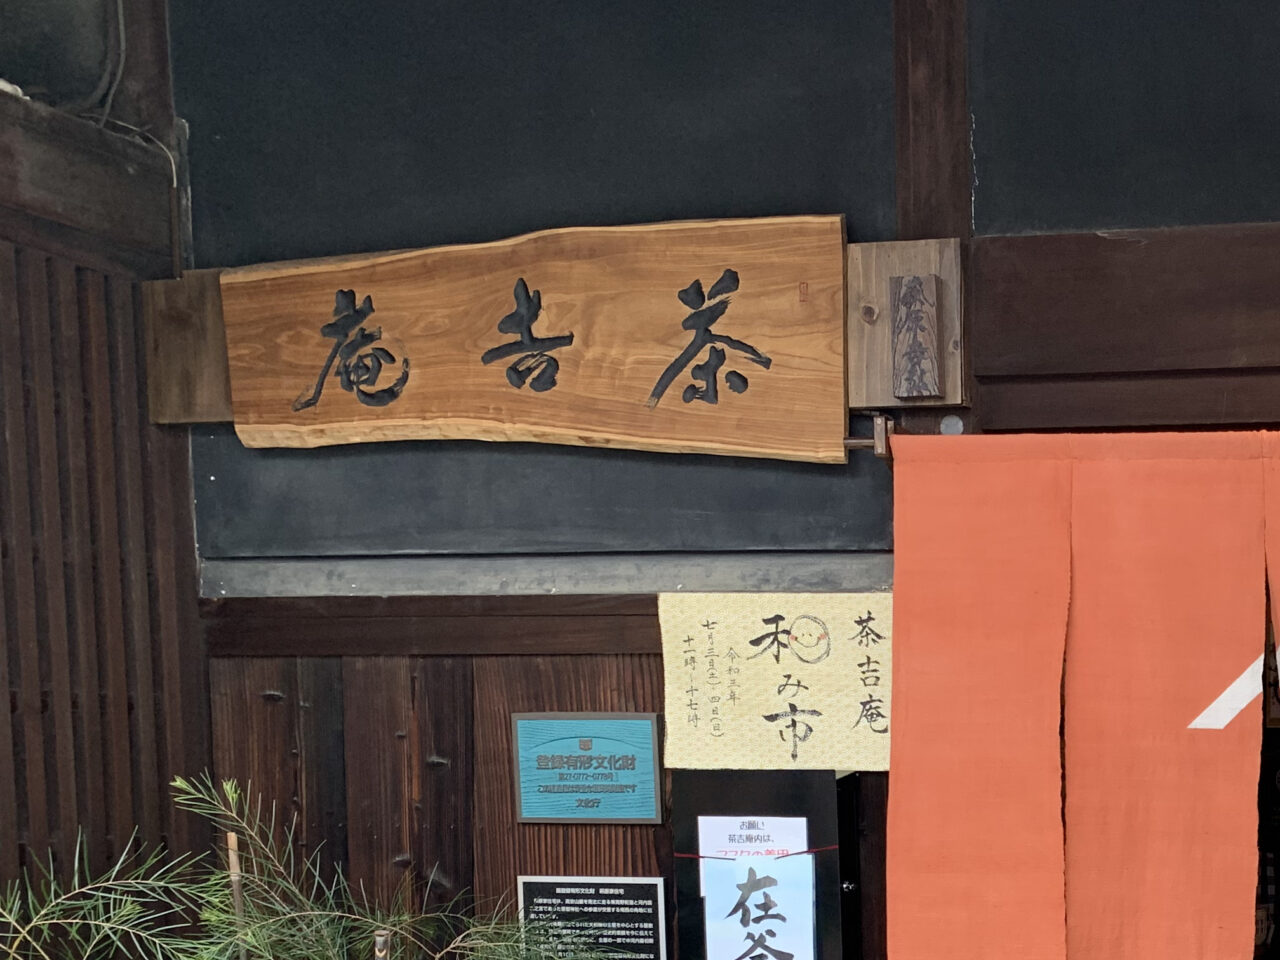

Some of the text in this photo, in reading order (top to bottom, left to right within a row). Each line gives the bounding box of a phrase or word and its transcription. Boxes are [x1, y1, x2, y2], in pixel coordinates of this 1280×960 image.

[722, 647, 741, 706] 令和三年
[848, 610, 889, 734] 茶吉庵
[740, 820, 765, 831] お願い
